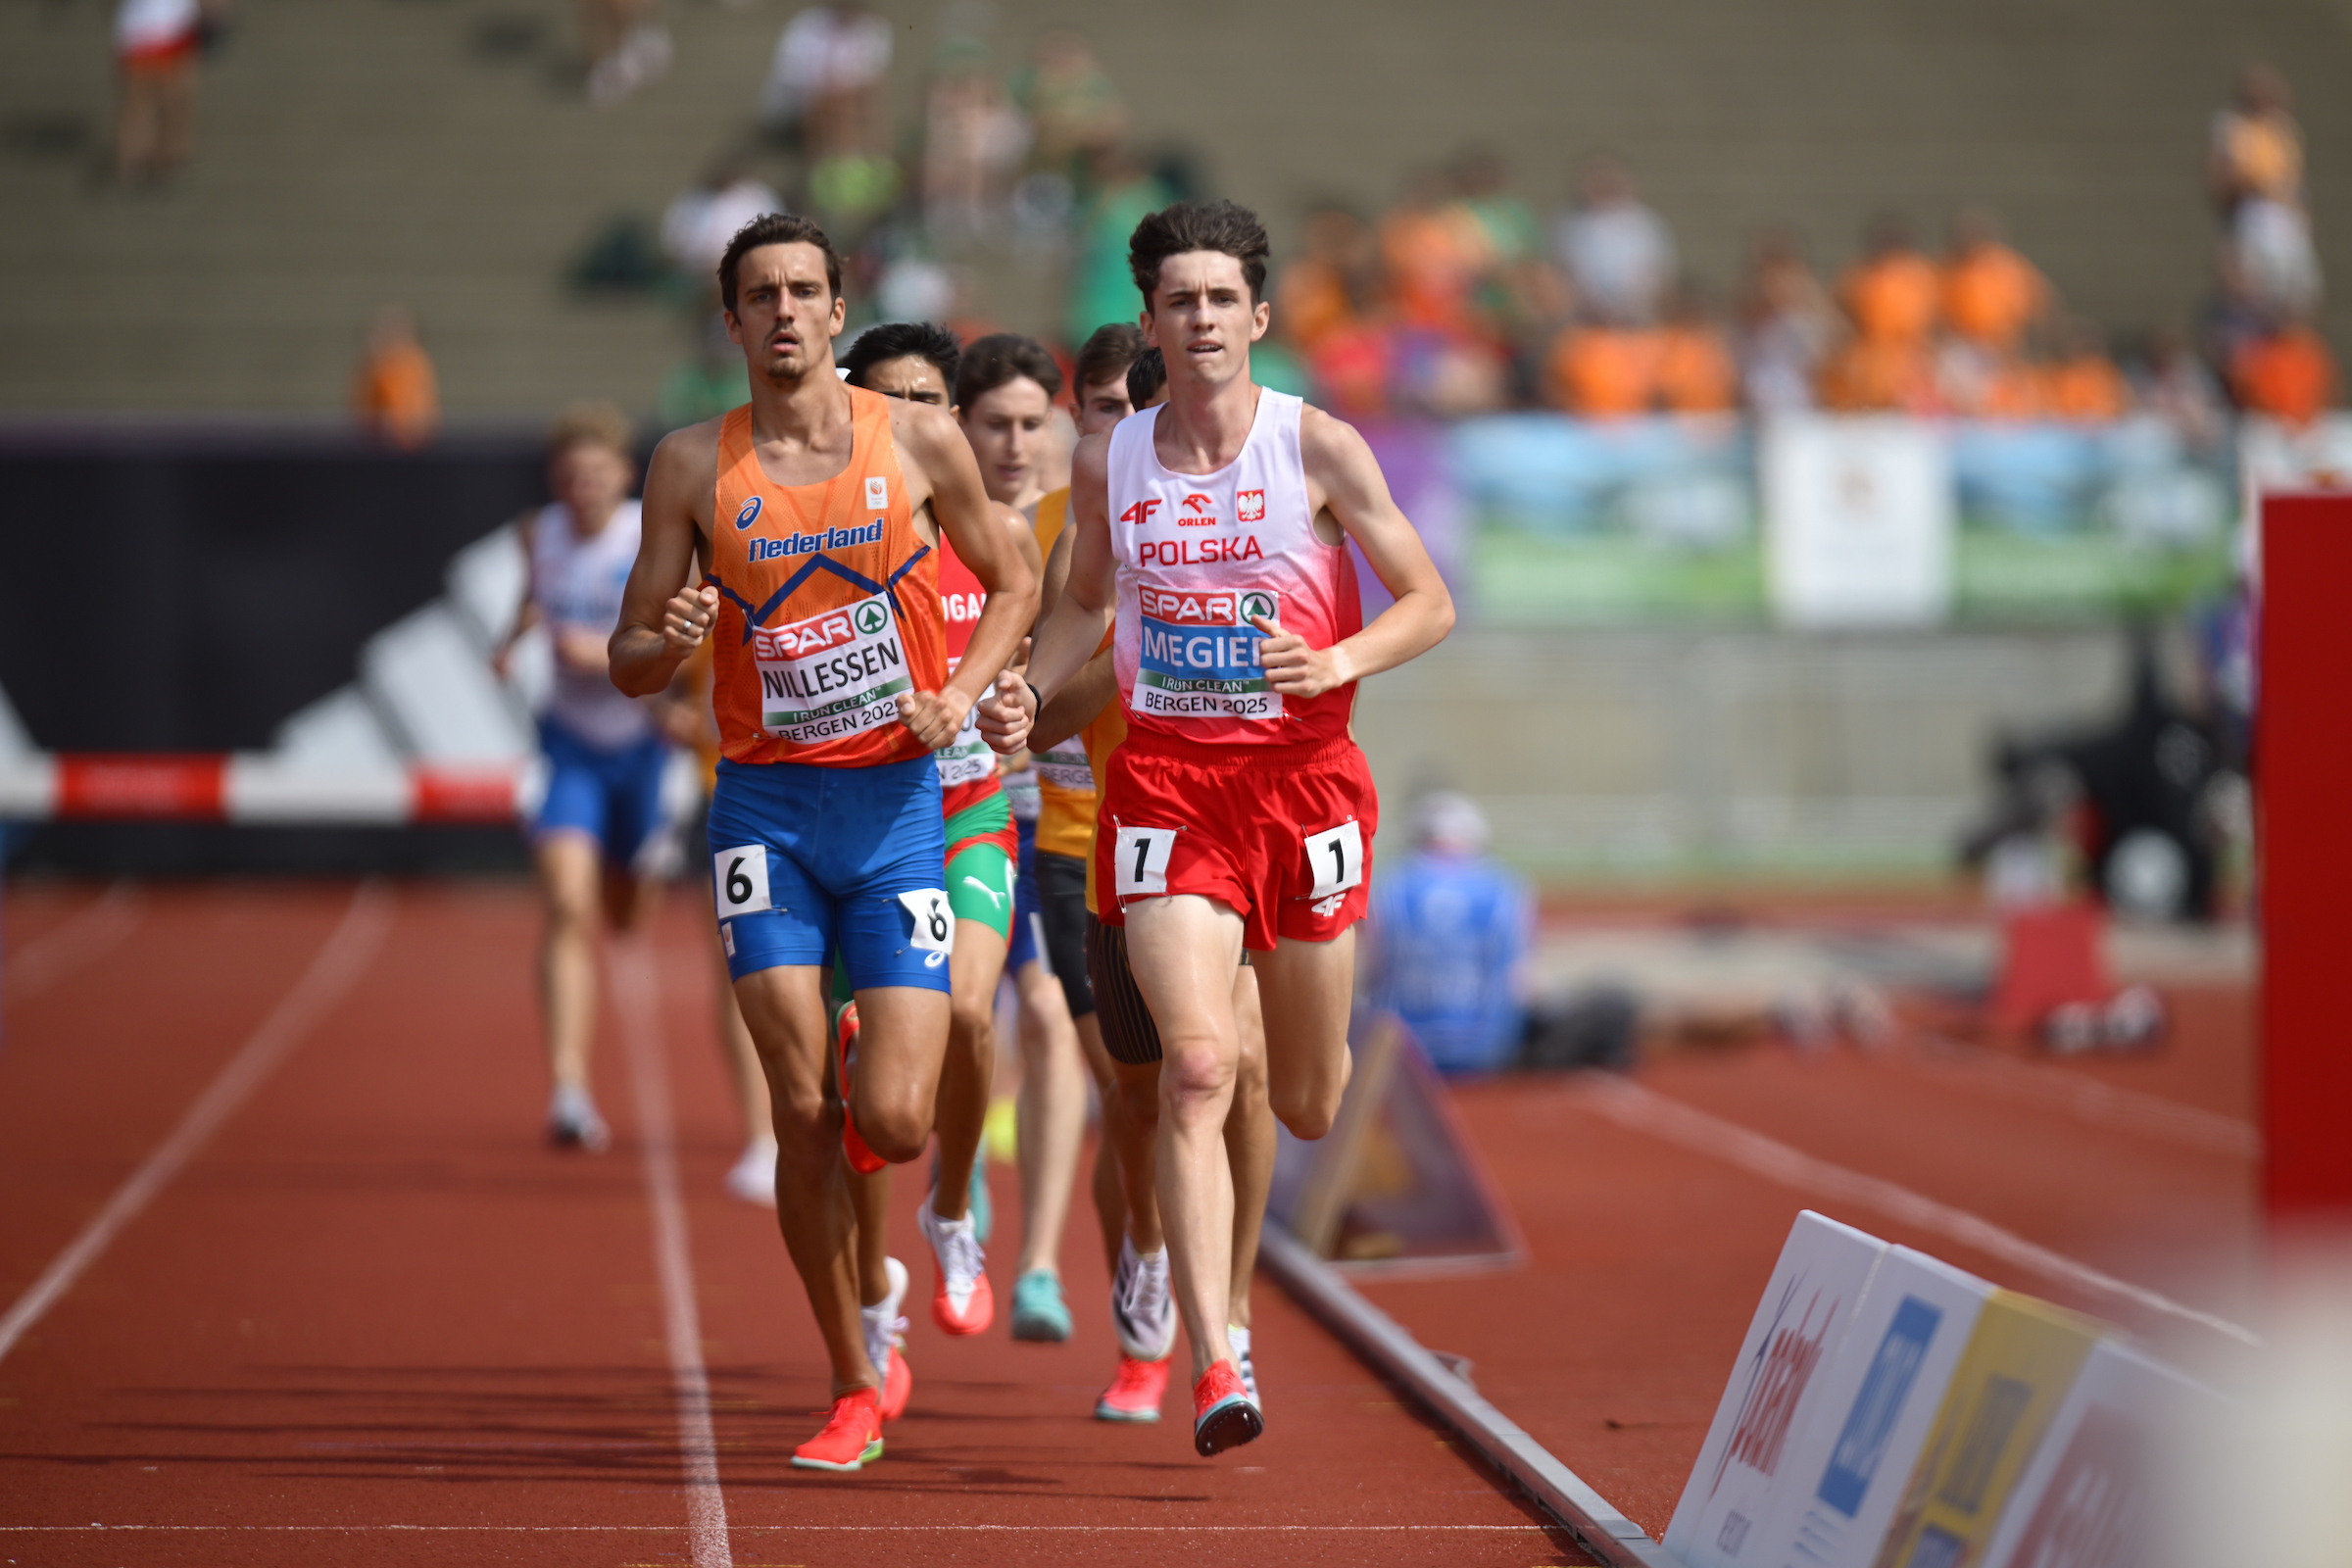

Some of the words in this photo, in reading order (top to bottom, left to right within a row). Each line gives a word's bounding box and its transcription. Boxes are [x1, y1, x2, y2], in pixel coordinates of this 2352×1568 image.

[1120, 499, 1162, 524] 4F
[1178, 517, 1216, 526] ORLEN
[749, 517, 884, 563] Nederland
[1140, 535, 1263, 566] POLSKA
[1141, 589, 1233, 621] SPAR
[756, 616, 852, 658] SPAR
[762, 637, 900, 699] NILLESSEN
[1167, 677, 1193, 691] RUN
[793, 712, 799, 723] I
[801, 707, 831, 722] RUN
[1146, 691, 1217, 711] BERGEN
[1222, 698, 1267, 714] 2025
[778, 714, 858, 741] BERGEN
[1134, 838, 1152, 883] 1
[1328, 837, 1345, 884] 1
[726, 856, 753, 905] 6
[927, 897, 948, 942] 6
